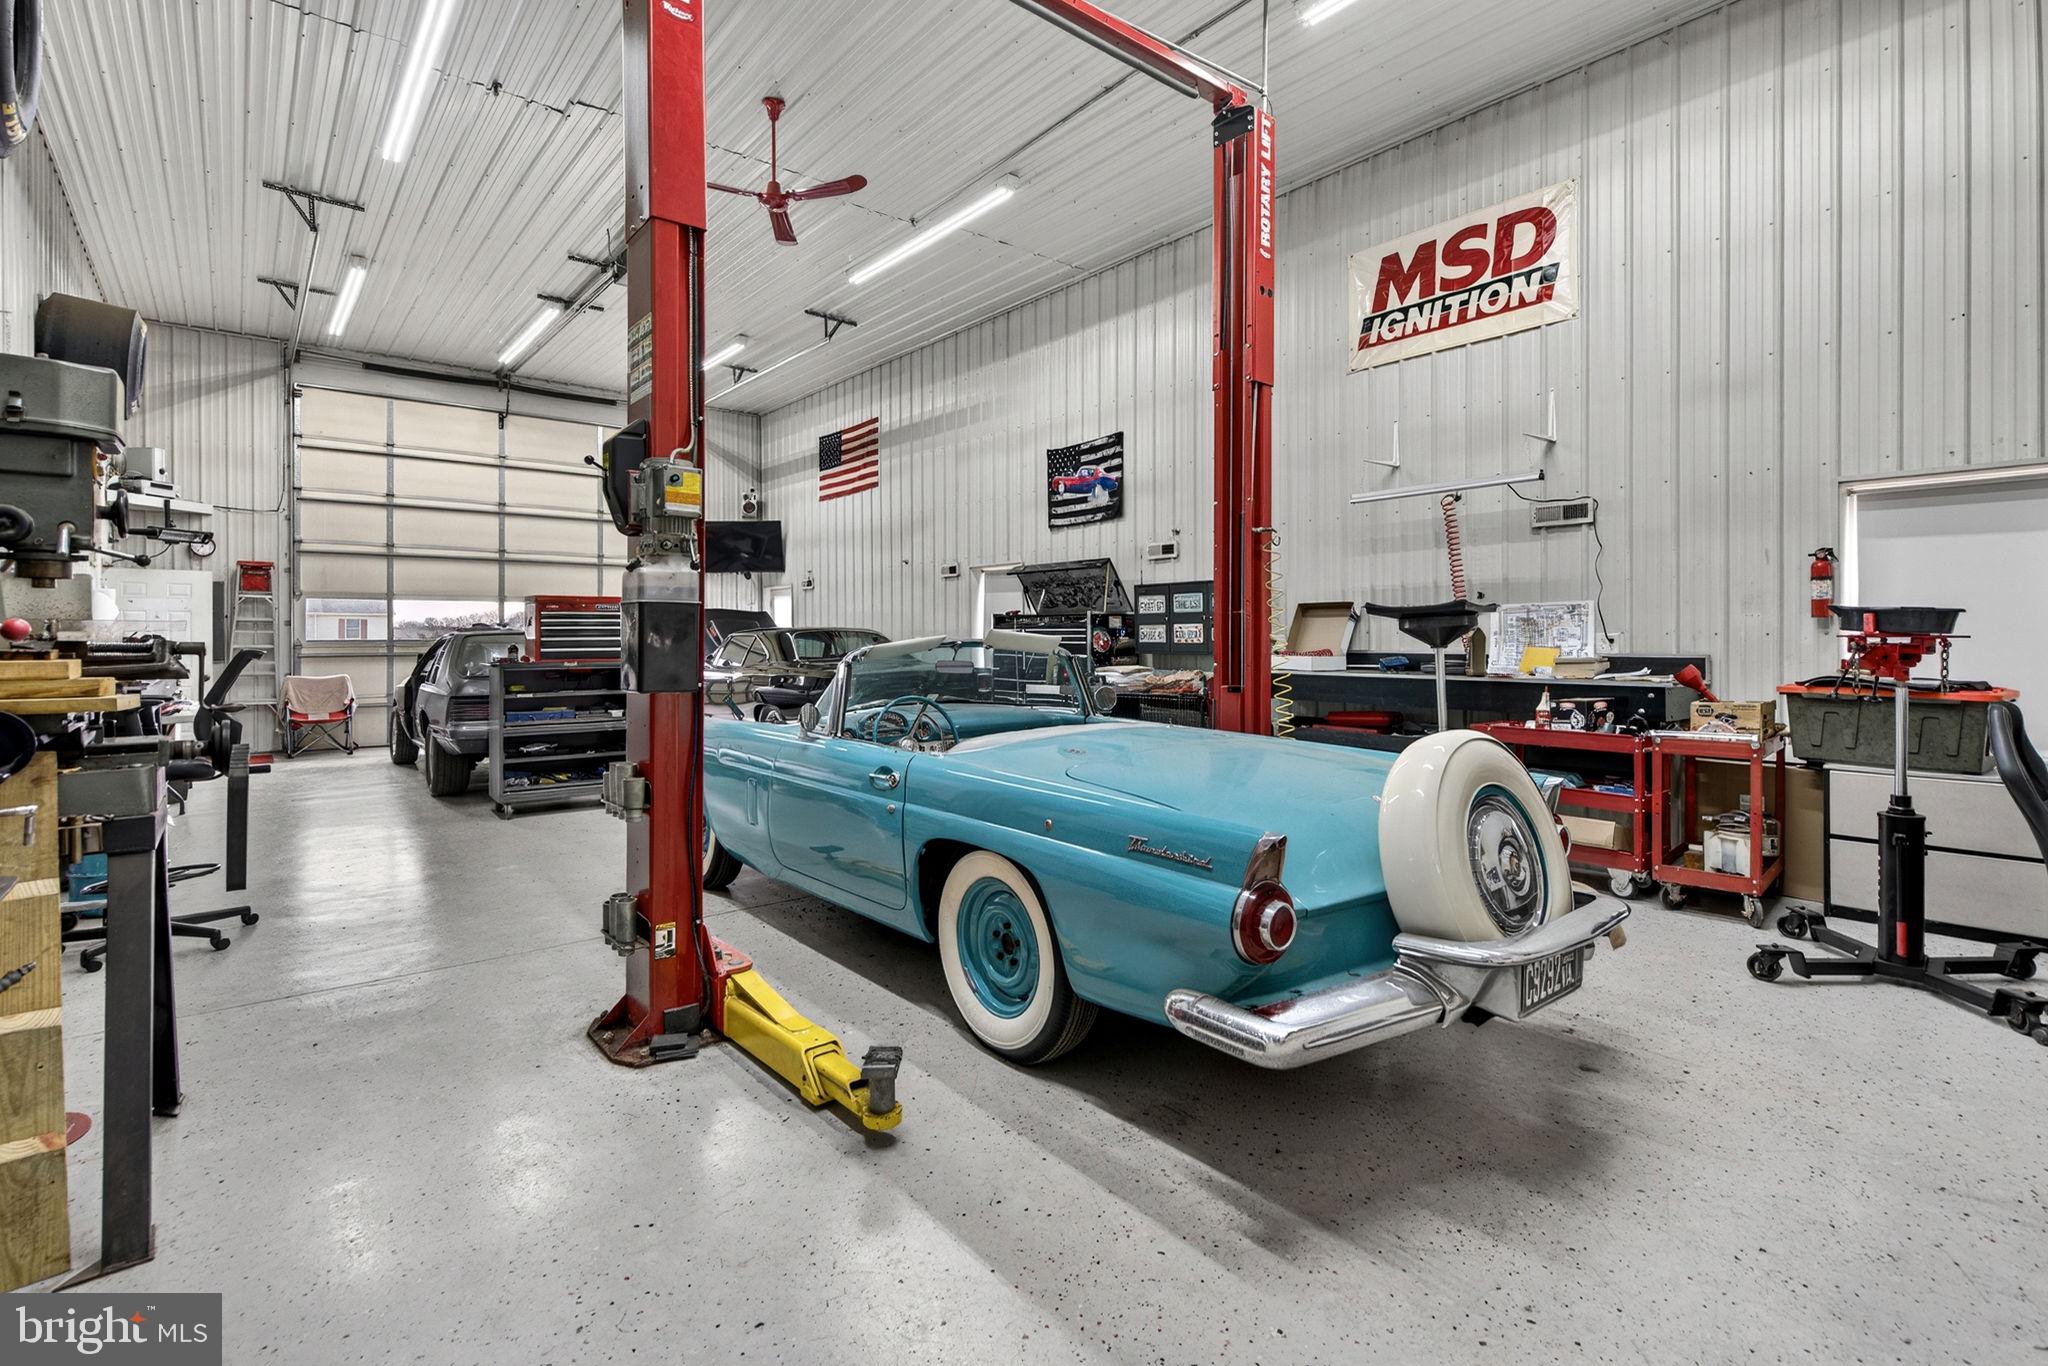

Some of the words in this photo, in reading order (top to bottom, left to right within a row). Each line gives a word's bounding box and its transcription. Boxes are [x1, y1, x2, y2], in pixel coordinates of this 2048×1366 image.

[1260, 113, 1273, 160] LIFT
[1260, 162, 1271, 247] ROTARY
[1371, 206, 1558, 314] MSD
[1368, 270, 1542, 344] IGNITION
[1128, 834, 1213, 869] Thunderbird
[1525, 954, 1561, 1007] C9292
